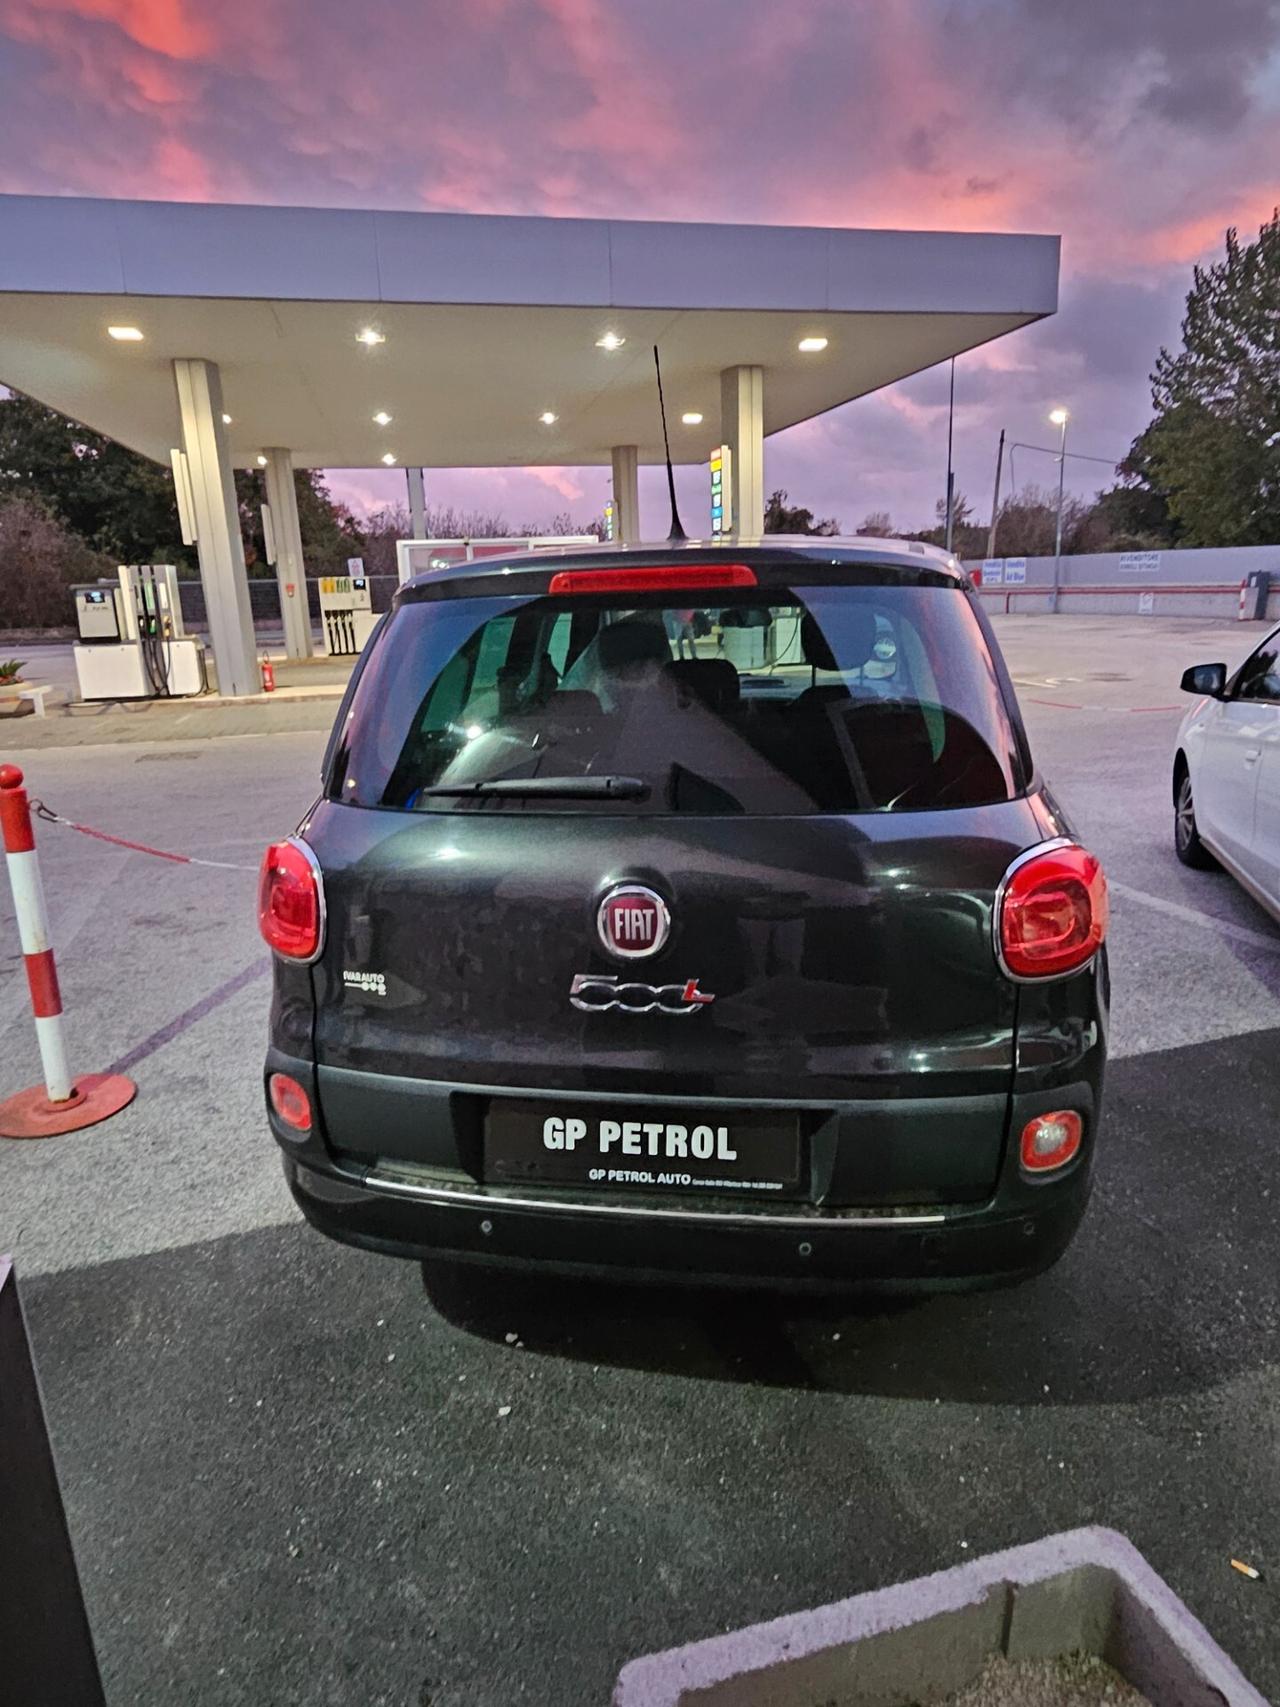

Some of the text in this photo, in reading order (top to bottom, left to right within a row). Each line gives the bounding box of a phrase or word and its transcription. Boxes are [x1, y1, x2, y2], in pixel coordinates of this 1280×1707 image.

[614, 908, 655, 940] FIAT
[569, 973, 716, 1014] 500L
[543, 1117, 738, 1161] GP PETROL
[588, 1168, 606, 1180] GP
[608, 1169, 656, 1184] PETROL
[656, 1172, 691, 1185] AUTO
